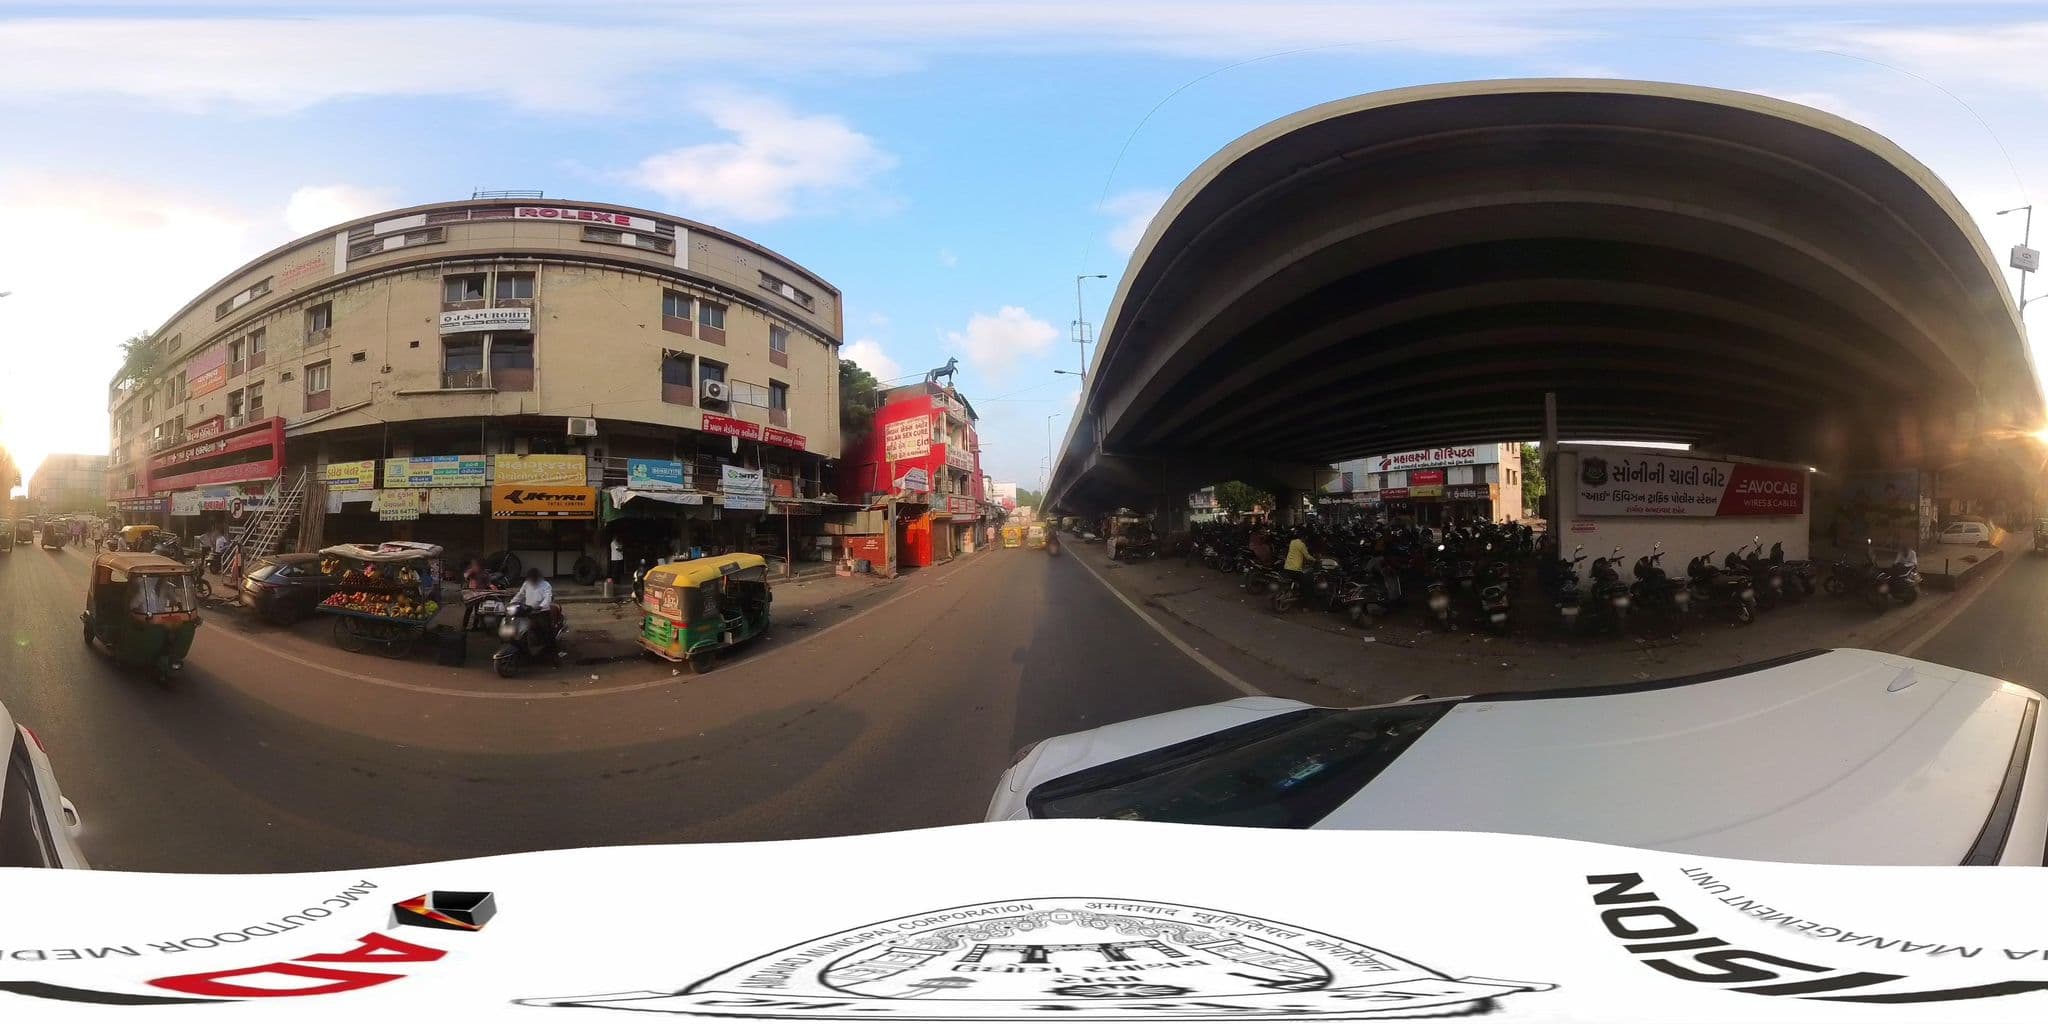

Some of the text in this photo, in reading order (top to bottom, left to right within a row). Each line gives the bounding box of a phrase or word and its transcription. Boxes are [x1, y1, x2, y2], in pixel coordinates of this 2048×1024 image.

[518, 207, 631, 226] ROLEXE
[902, 431, 912, 439] SEX
[913, 428, 928, 437] CURE
[1612, 459, 1725, 487] સોનીની ચાલી બીટ
